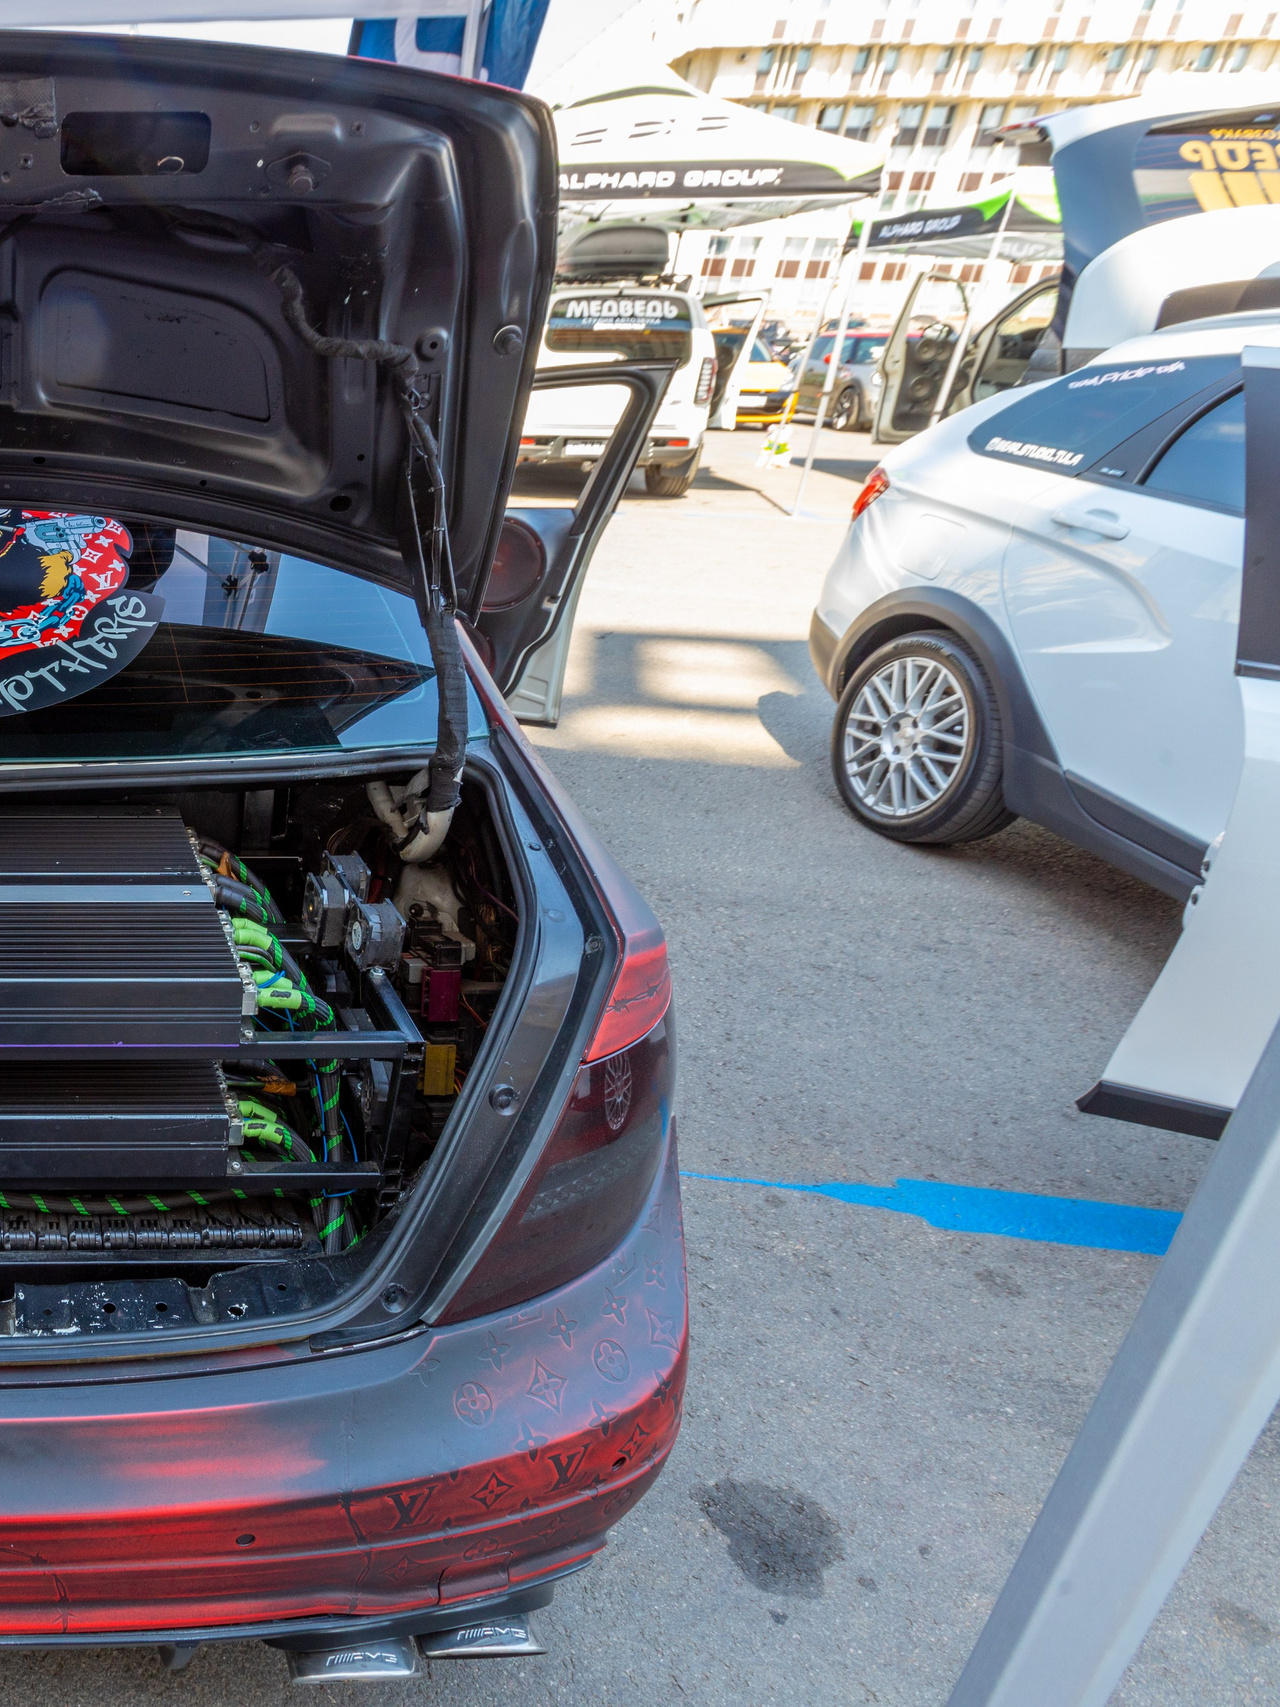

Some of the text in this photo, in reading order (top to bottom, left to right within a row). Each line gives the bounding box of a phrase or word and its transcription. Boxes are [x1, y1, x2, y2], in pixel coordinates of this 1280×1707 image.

[1179, 140, 1280, 171] ЕДЬ
[878, 214, 963, 239] ALPHARD GROUP
[565, 299, 679, 319] МЕДВЕДЬ
